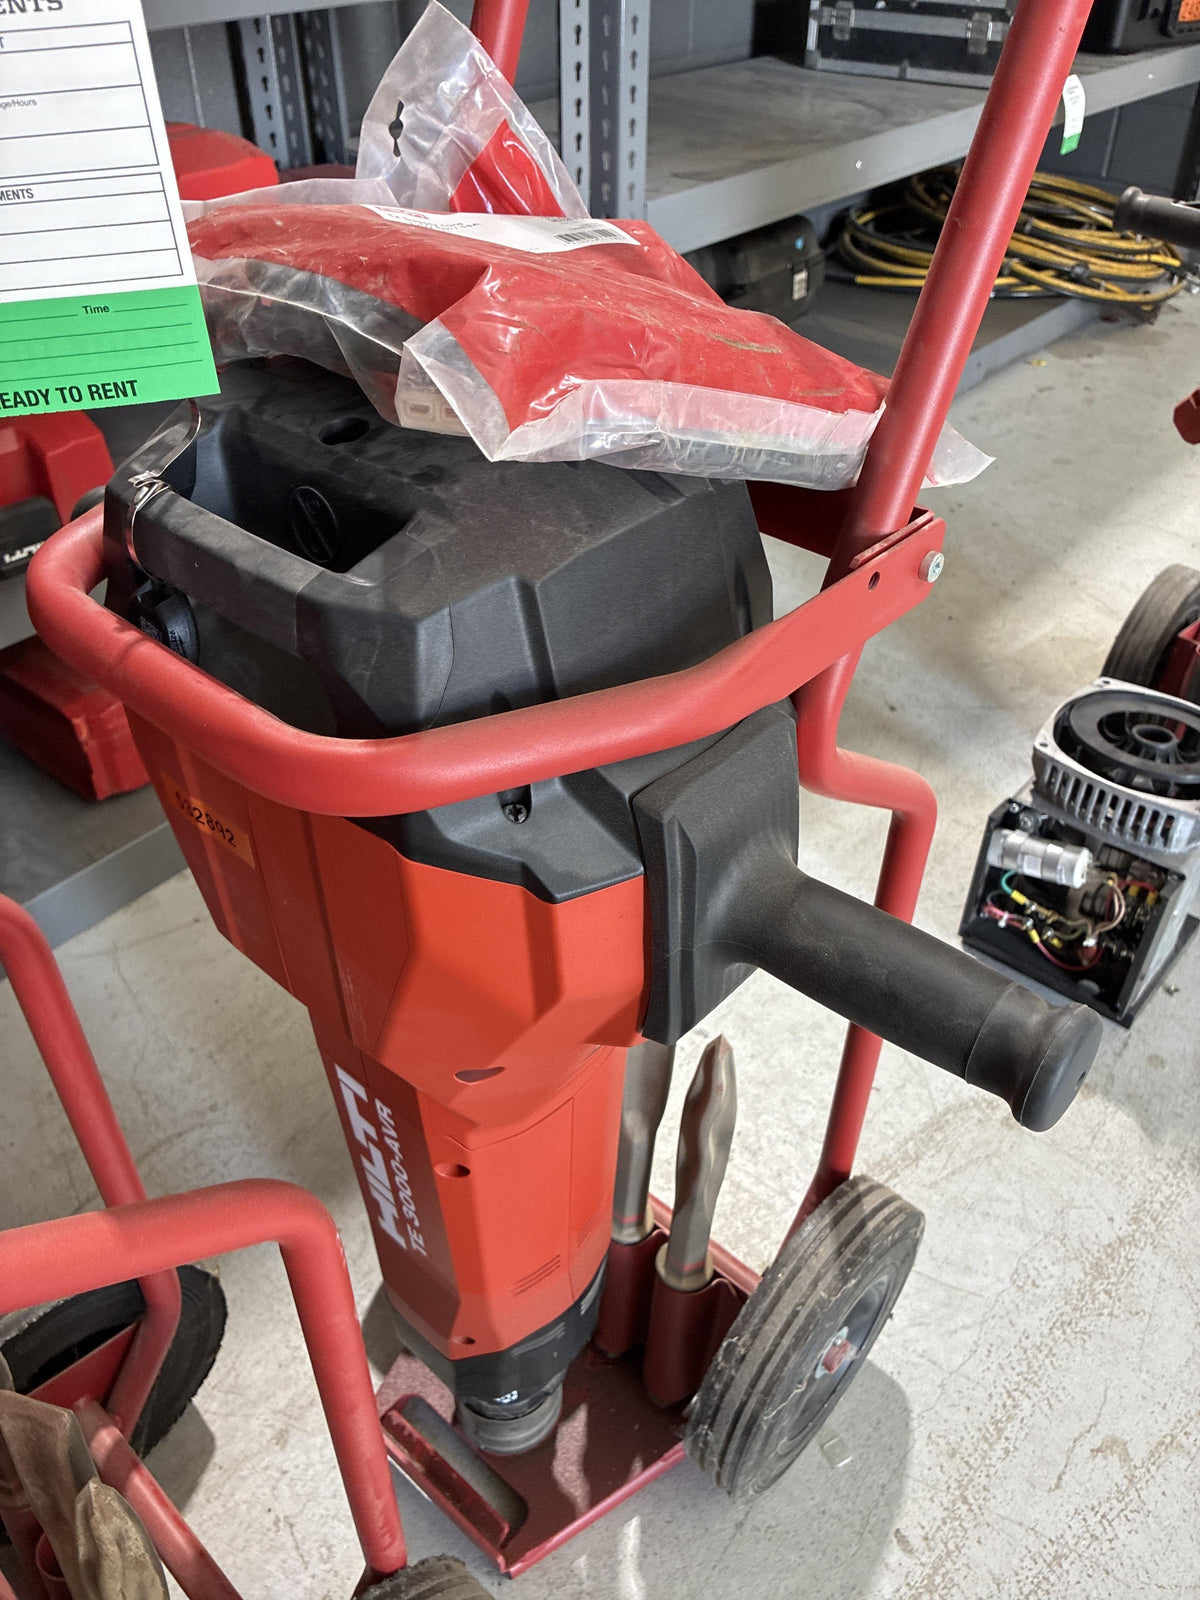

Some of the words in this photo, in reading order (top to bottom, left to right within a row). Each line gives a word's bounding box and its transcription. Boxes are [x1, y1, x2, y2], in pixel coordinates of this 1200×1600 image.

[0, 98, 37, 110] ge/Hours
[82, 304, 110, 315] Time
[0, 388, 50, 410] EADY
[55, 384, 83, 404] TO
[87, 379, 138, 400] RENT
[334, 1062, 408, 1250] HILTI
[374, 1097, 420, 1228] 3000-AVR
[407, 1223, 428, 1257] TE
